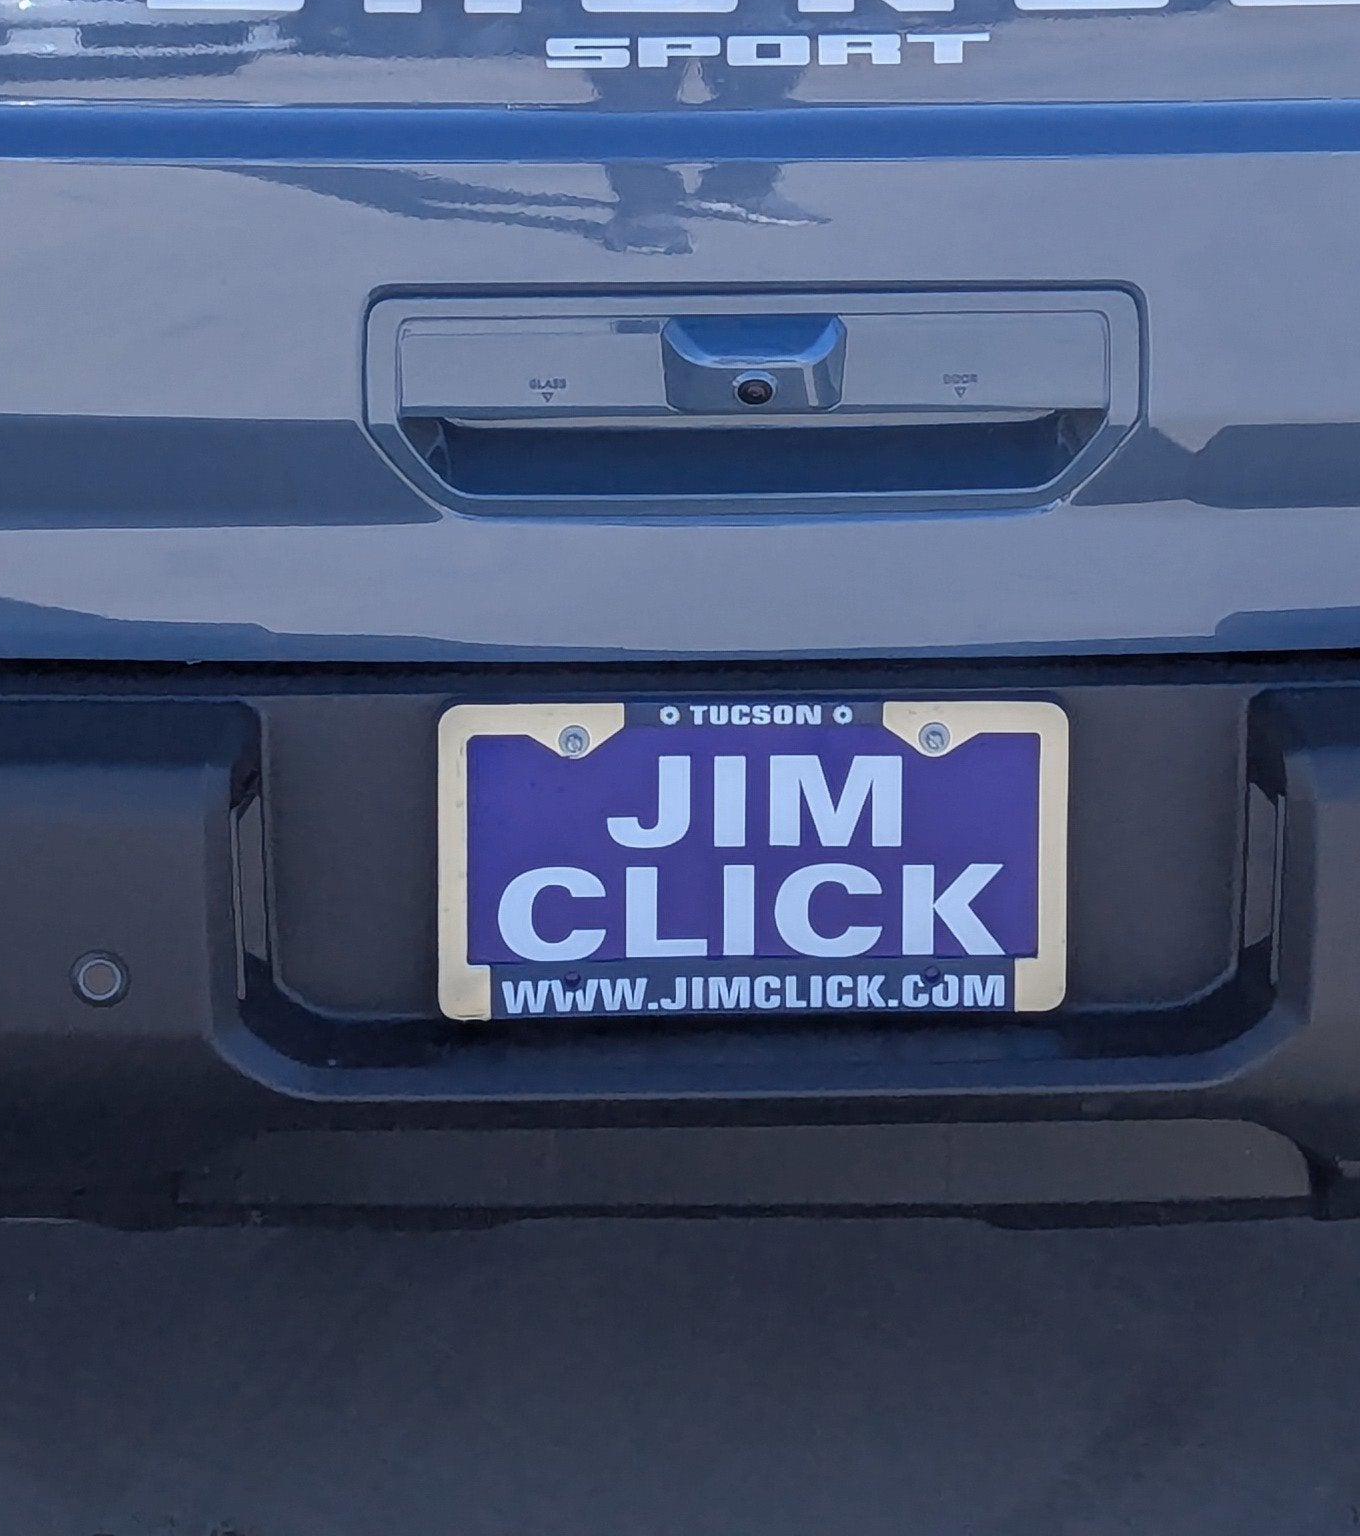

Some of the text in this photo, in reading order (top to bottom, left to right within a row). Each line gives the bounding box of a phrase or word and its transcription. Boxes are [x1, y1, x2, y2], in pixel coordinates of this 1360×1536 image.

[545, 32, 990, 68] SPORT
[689, 704, 822, 726] TUCSON
[606, 755, 903, 849] JIM
[497, 863, 1006, 962] CLICK
[501, 972, 1006, 1015] WWW.JIMCLICK.COM
